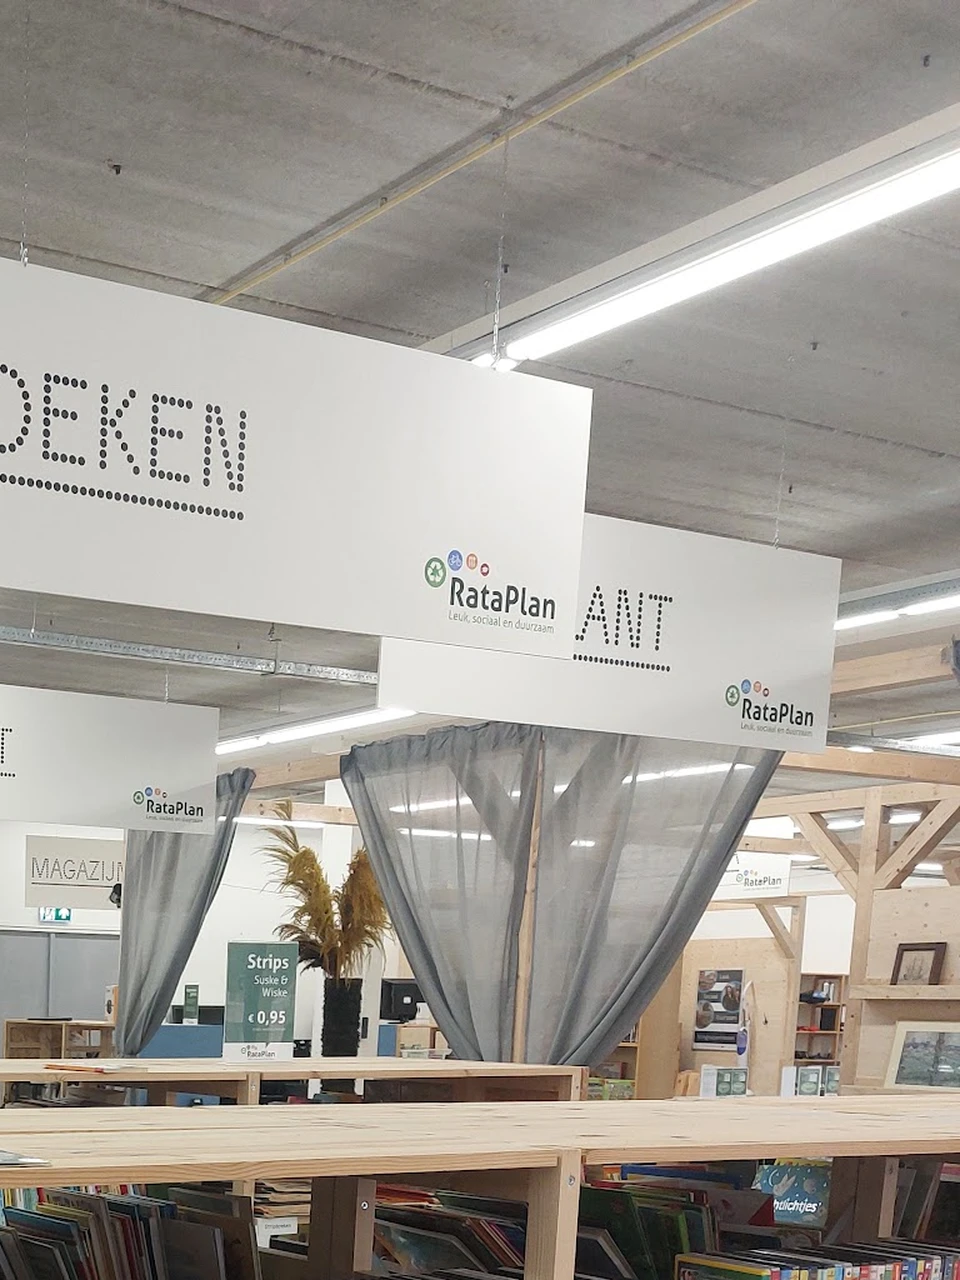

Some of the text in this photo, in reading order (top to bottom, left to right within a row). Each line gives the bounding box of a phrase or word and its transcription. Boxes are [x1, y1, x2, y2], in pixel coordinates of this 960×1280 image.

[449, 576, 556, 620] RataPlan
[448, 609, 555, 634] Leuk, sociaal en duurzaam
[575, 585, 673, 651] ANT
[742, 698, 814, 727] RataPlan
[146, 799, 203, 817] RataPlan
[743, 876, 782, 887] RataPlan
[247, 954, 289, 973] Strips
[253, 975, 288, 985] Suske &
[262, 987, 288, 998] Wiske
[257, 1011, 286, 1026] 0,95
